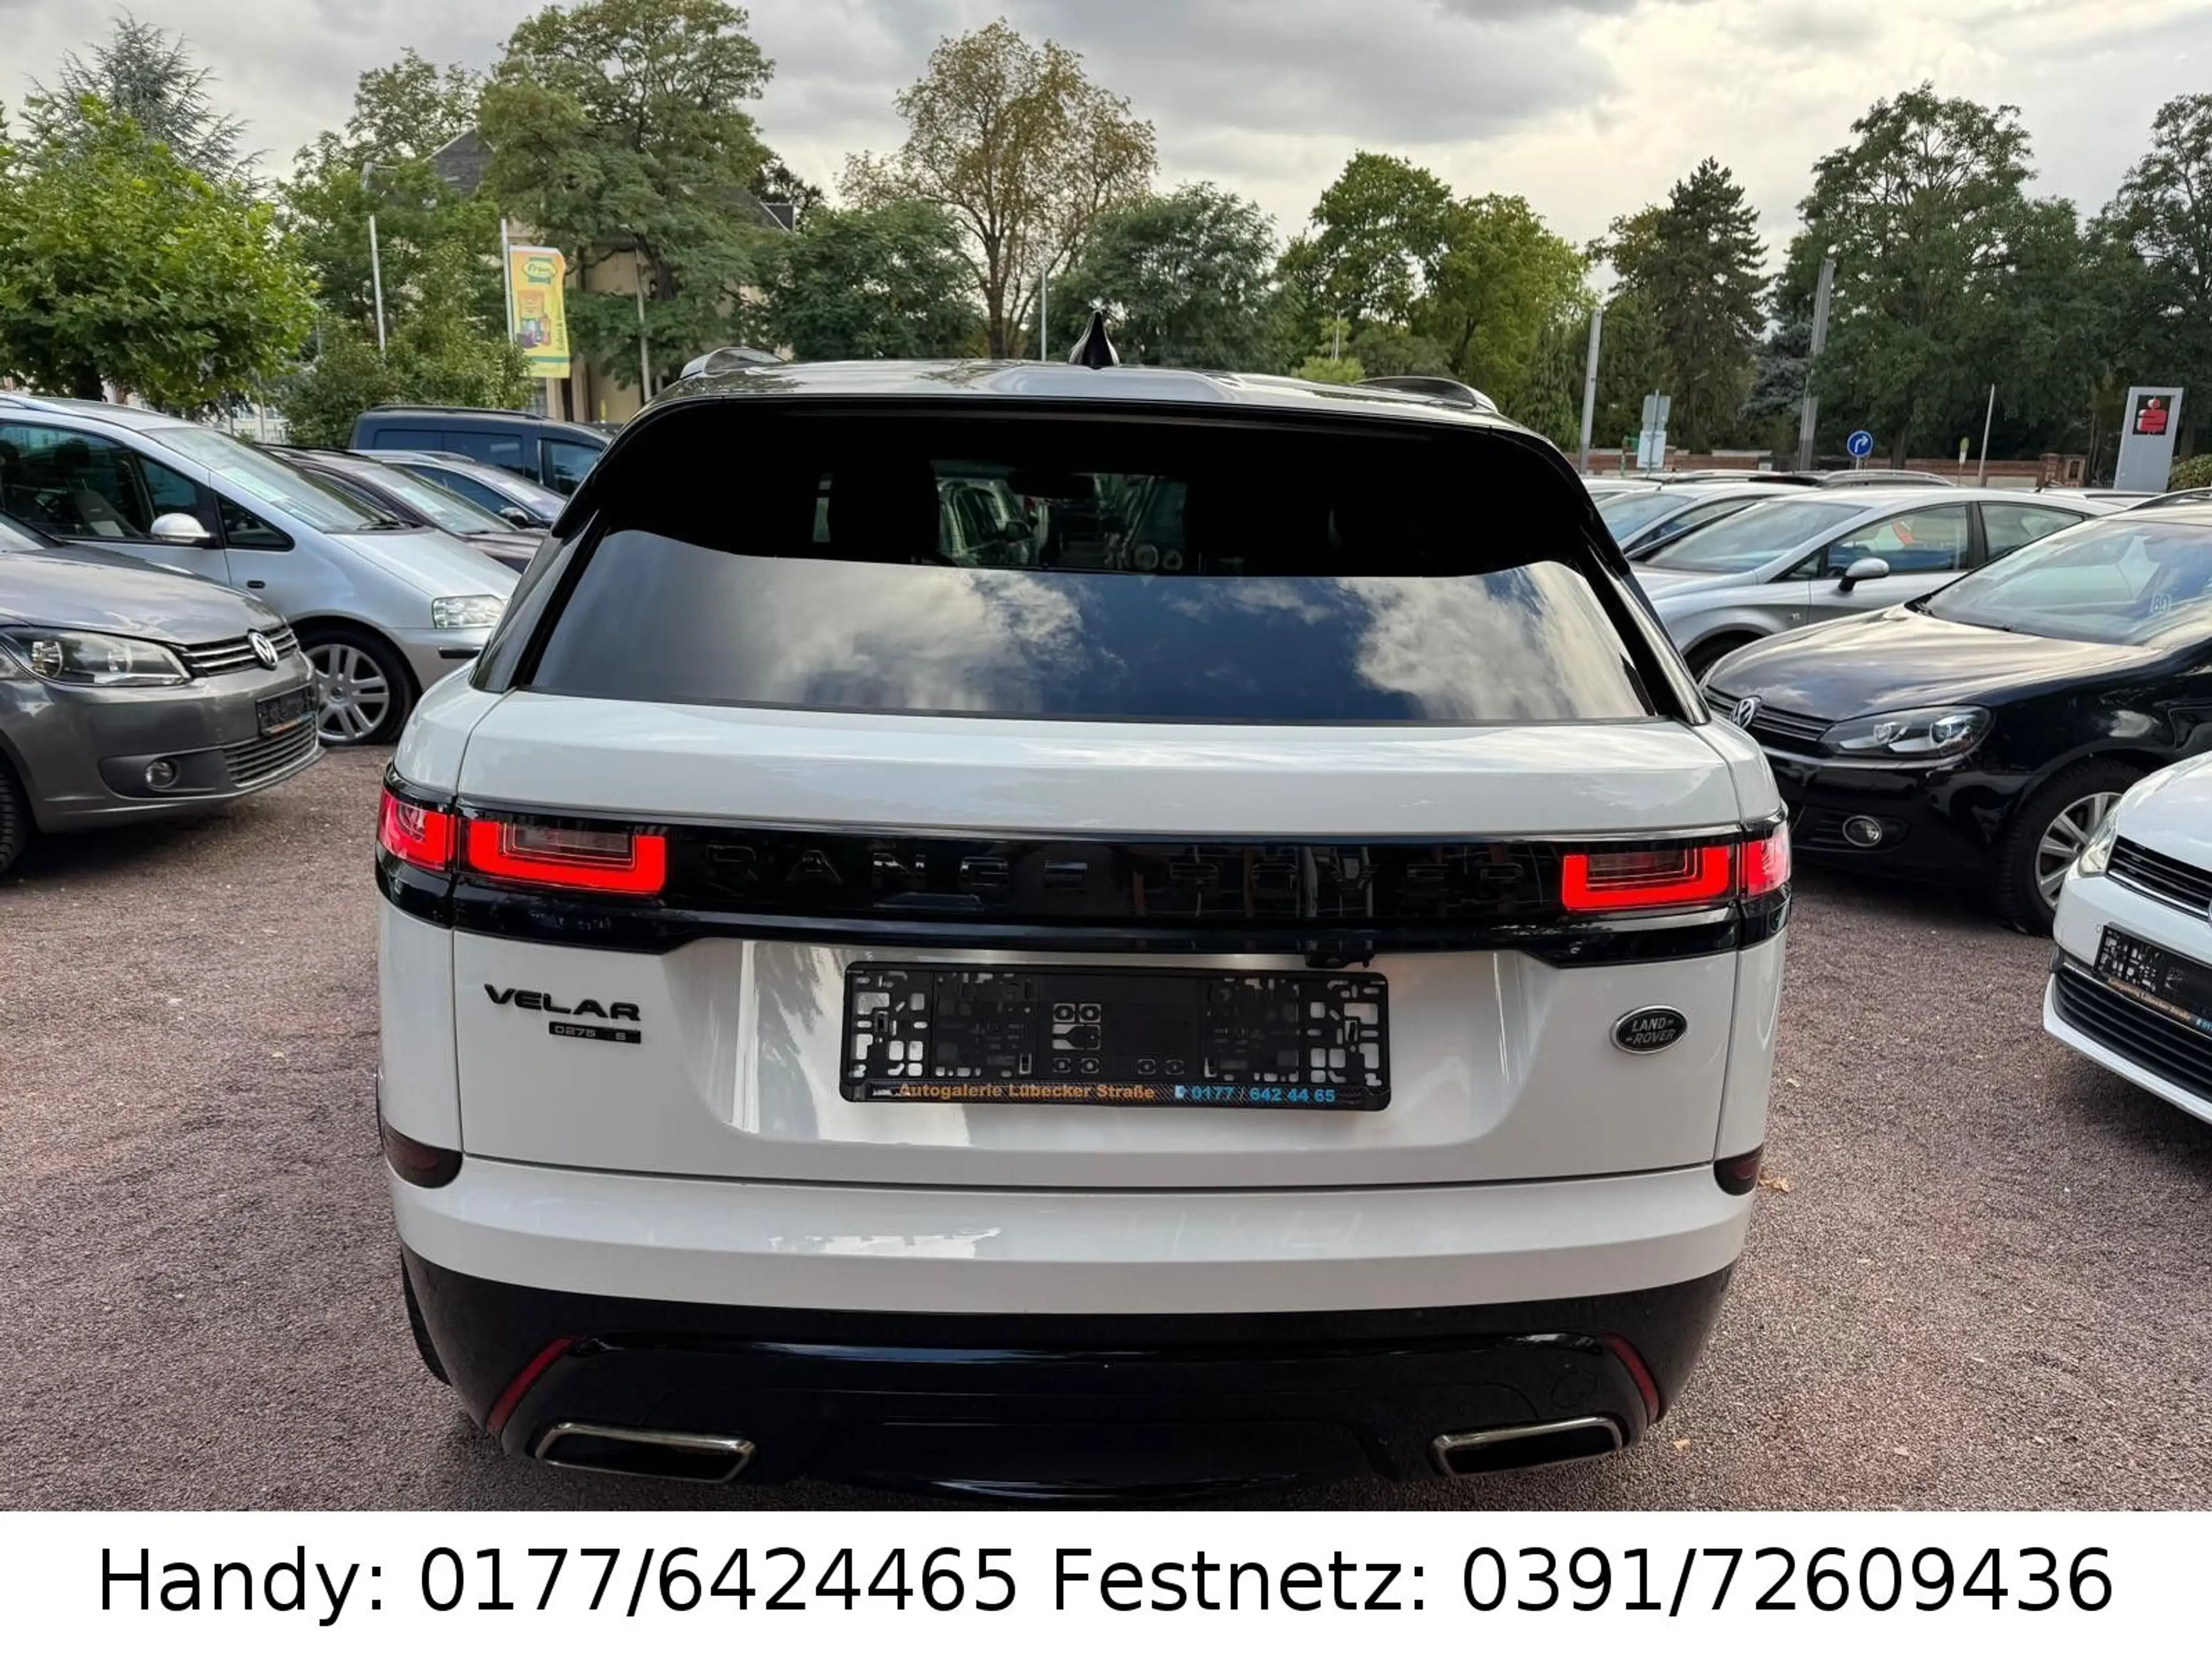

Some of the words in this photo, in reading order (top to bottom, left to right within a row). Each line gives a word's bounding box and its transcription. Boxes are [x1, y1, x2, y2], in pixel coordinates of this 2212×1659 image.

[484, 983, 641, 1021] VELAR
[1631, 1017, 1666, 1032] LAND
[554, 1025, 596, 1038] D275
[615, 1032, 626, 1041] S
[1633, 1028, 1676, 1044] ROVER
[899, 1083, 1002, 1100] Autogalerie
[1097, 1084, 1156, 1099] Straße
[1191, 1085, 1235, 1099] 0177
[1249, 1087, 1283, 1102] 642
[1286, 1088, 1309, 1101] 44
[1313, 1088, 1335, 1103] 65
